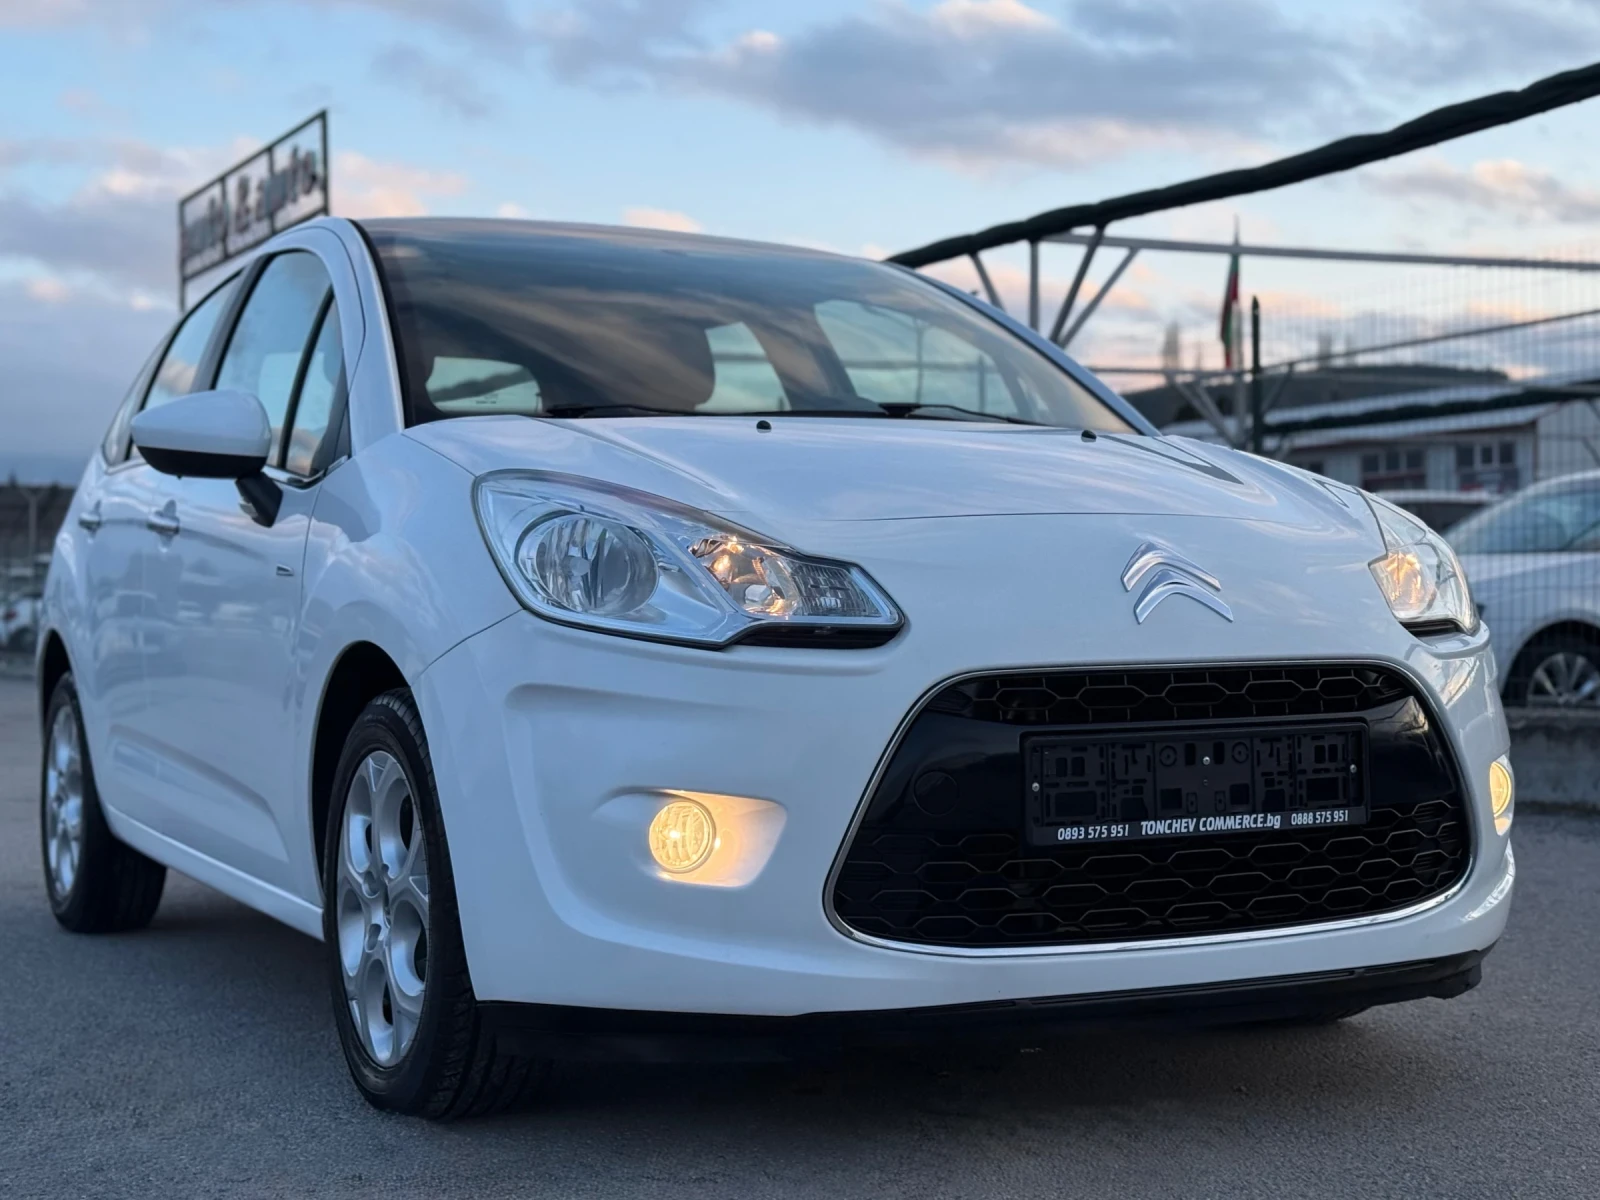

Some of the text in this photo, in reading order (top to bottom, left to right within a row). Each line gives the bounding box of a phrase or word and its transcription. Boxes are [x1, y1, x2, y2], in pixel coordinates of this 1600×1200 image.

[1057, 810, 1349, 841] 0893 575 951 TONCHEV COMMERCE.bg 0888 575 951
